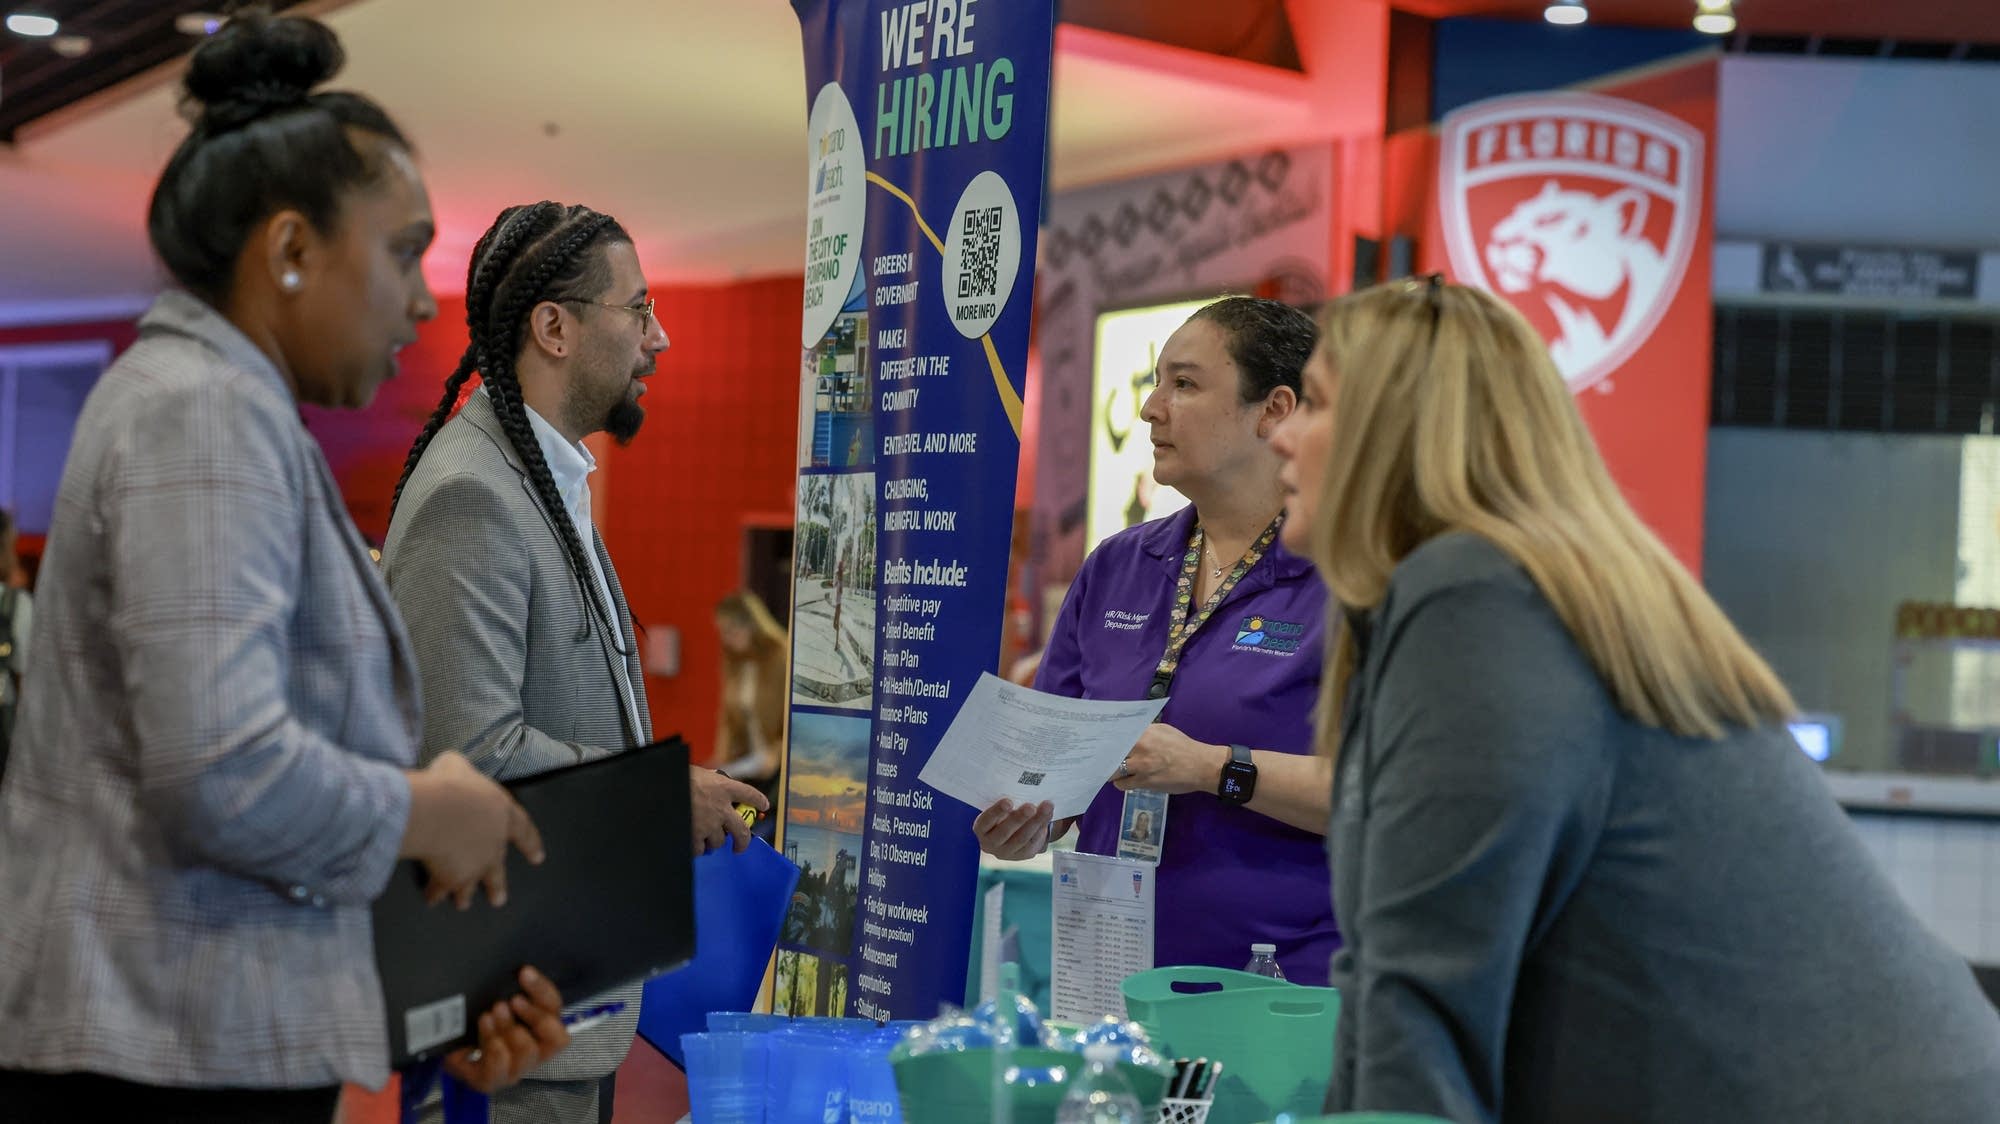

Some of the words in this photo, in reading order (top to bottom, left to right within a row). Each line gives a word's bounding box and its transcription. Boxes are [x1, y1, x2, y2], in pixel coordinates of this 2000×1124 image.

[880, 0, 977, 72] WE'RE
[874, 57, 1015, 160] HIRING
[1475, 119, 1670, 178] FLORIDA
[818, 235, 832, 260] CITY
[833, 234, 848, 256] OF
[806, 258, 840, 286] POMPANO
[873, 253, 908, 277] CAREERS
[955, 305, 979, 321] MORE
[978, 304, 996, 320] INFO
[878, 328, 903, 350] MAKE
[916, 356, 929, 377] IN
[929, 356, 951, 377] THE
[923, 433, 947, 453] AND
[948, 432, 977, 454] MORE
[923, 511, 957, 532] WORK
[912, 558, 968, 587] Include:
[921, 599, 942, 618] pay
[902, 622, 935, 641] Benefit
[1103, 618, 1144, 630] Department
[899, 648, 919, 668] Plan
[903, 704, 929, 725] Plans
[893, 732, 909, 756] Pay
[895, 788, 912, 808] and
[912, 789, 934, 811] Sick
[892, 816, 931, 839] Personal
[880, 842, 889, 860] 13
[889, 843, 928, 867] Observed
[887, 900, 929, 925] workweek
[881, 925, 889, 939] on
[888, 926, 915, 947] position)
[874, 1003, 891, 1023] Loan
